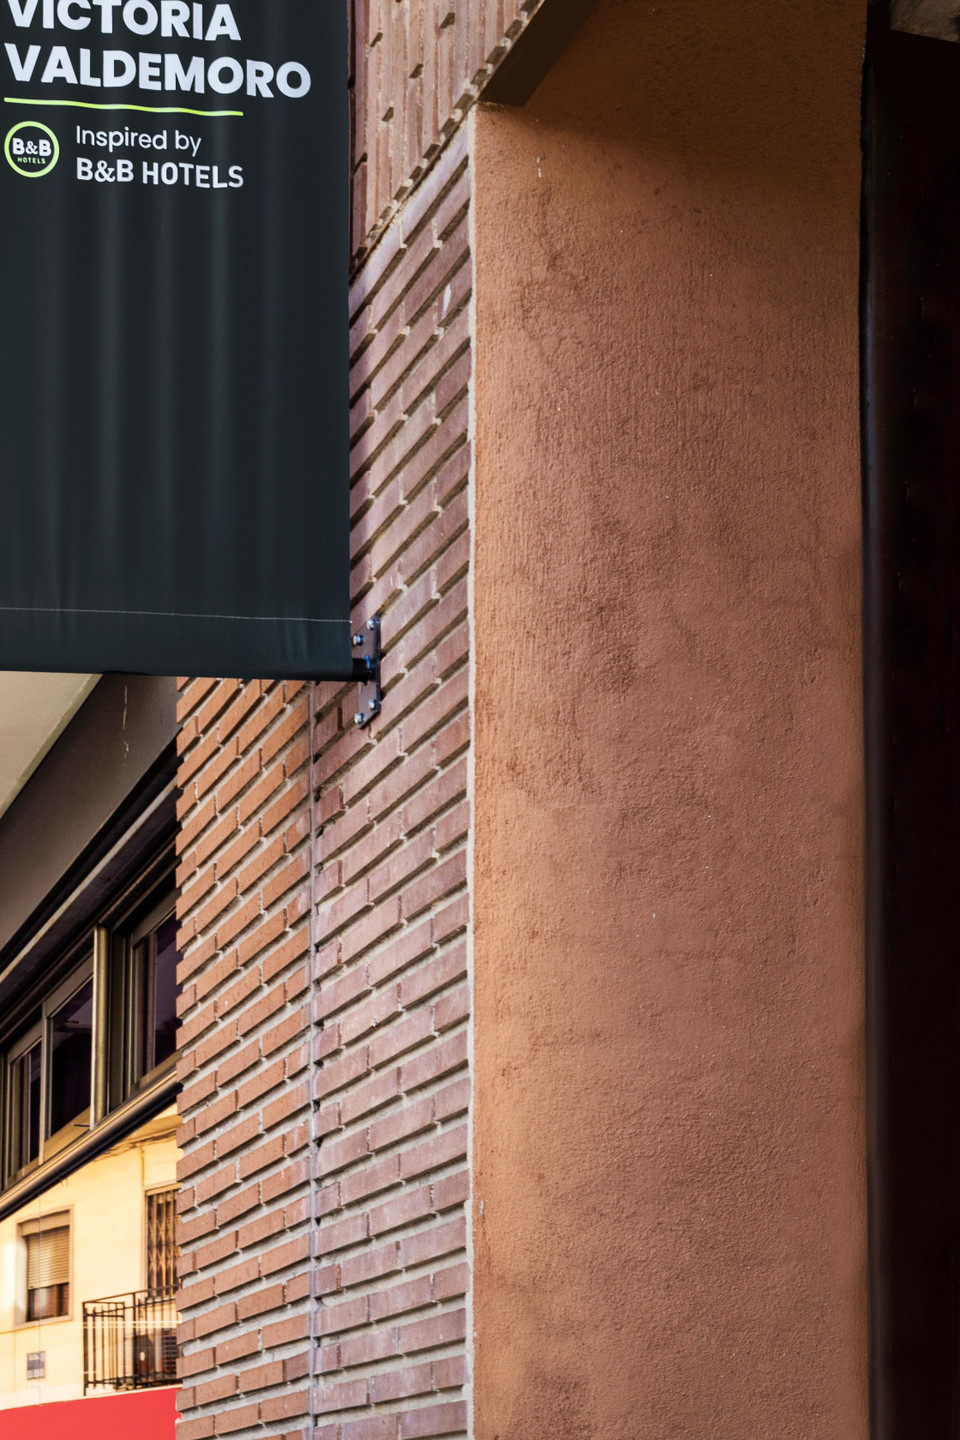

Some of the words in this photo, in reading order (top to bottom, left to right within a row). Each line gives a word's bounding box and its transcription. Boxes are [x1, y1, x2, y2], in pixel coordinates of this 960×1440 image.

[4, 43, 311, 98] VALDEMORO
[12, 137, 52, 157] B&B
[75, 125, 168, 153] Inspired
[174, 129, 202, 158] by
[17, 157, 46, 165] HOTELS
[76, 157, 135, 183] B&B
[142, 161, 245, 190] HOTELS
